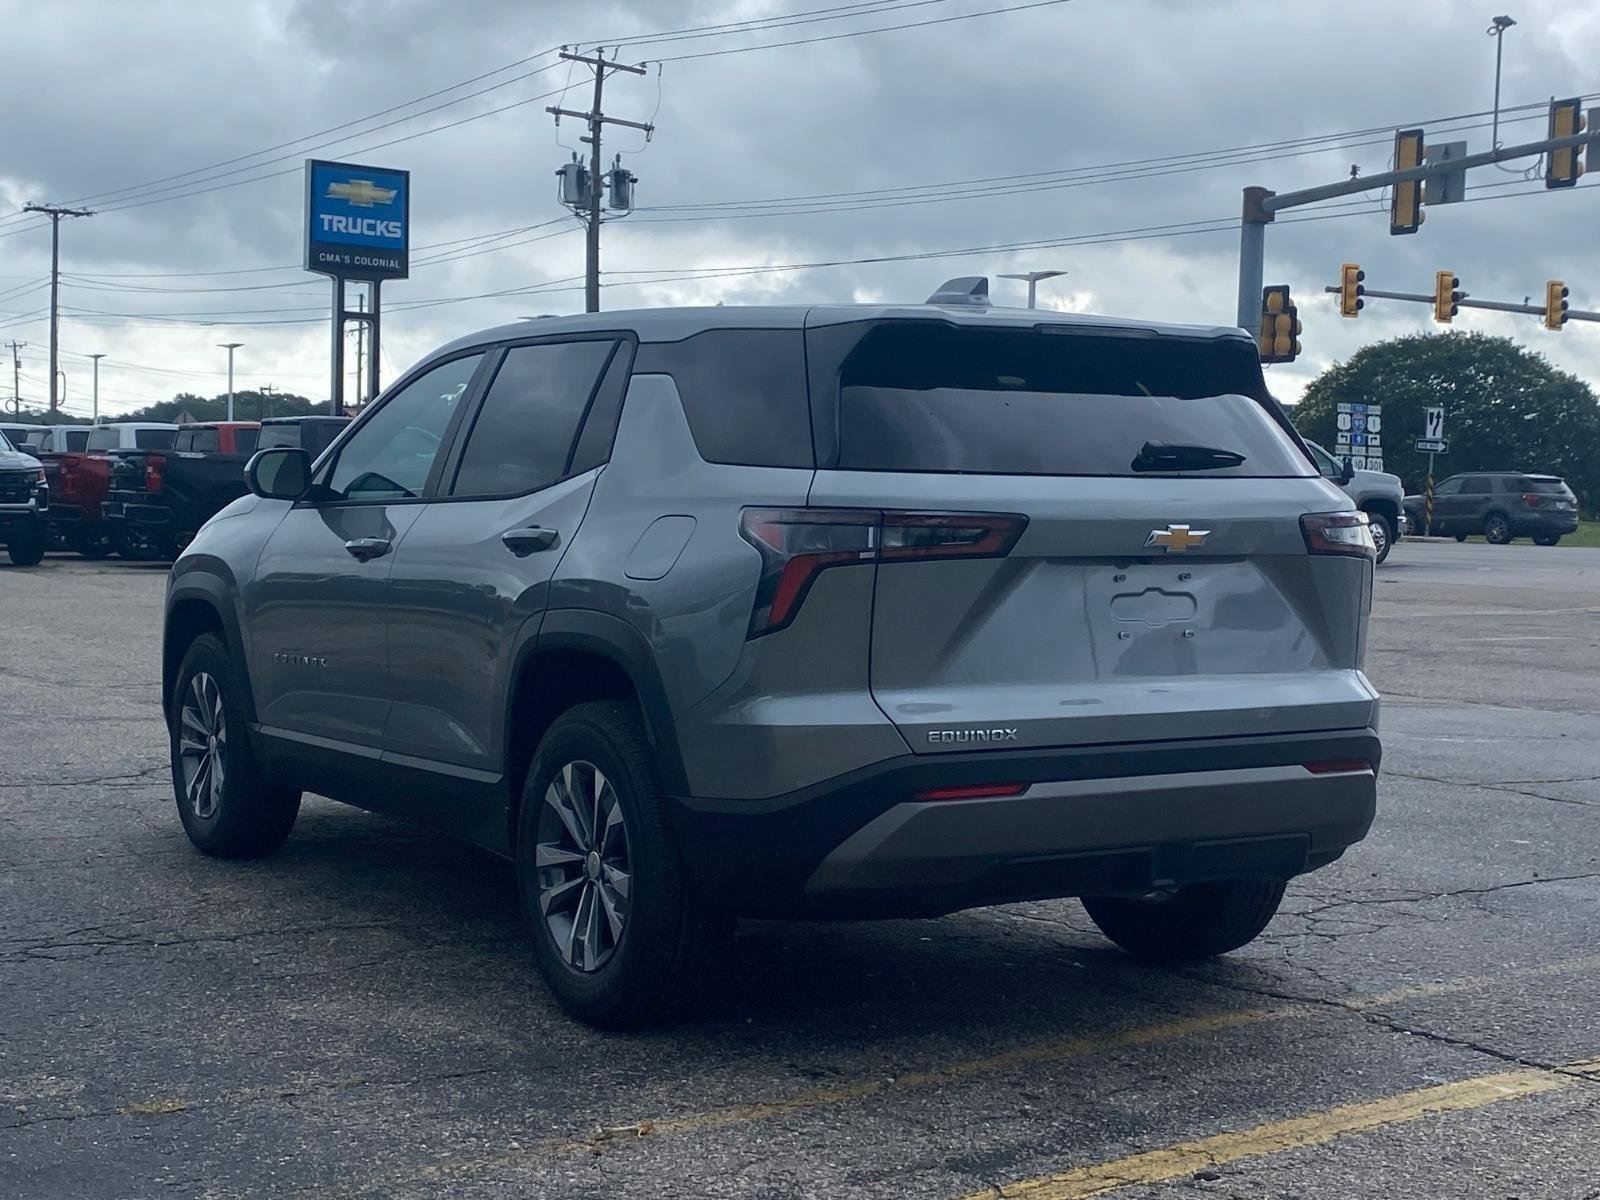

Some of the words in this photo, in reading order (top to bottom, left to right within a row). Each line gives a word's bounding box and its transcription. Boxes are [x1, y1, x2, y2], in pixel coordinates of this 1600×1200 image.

[319, 214, 402, 238] TRUCKS
[319, 252, 350, 264] CMA'S
[354, 256, 401, 269] COLONIAL
[1354, 420, 1364, 430] 95
[1369, 461, 1382, 471] 301
[928, 728, 1018, 743] EQUINOX
